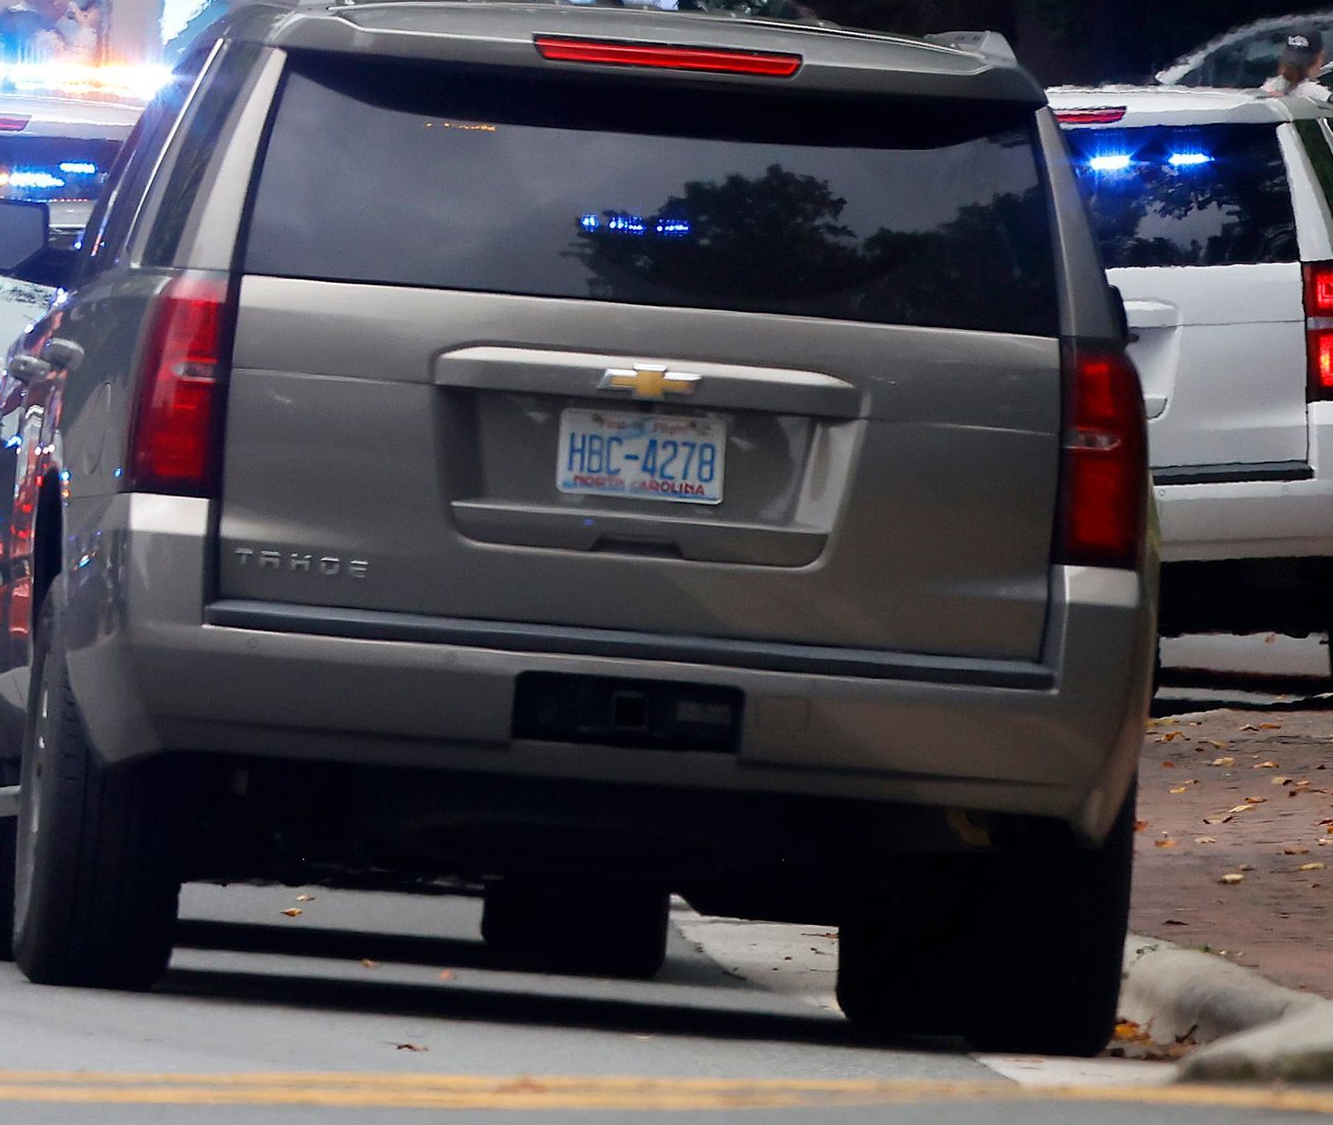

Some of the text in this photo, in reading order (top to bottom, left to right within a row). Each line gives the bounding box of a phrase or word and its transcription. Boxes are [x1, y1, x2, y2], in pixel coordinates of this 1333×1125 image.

[568, 432, 716, 483] HBC-4278
[573, 475, 706, 496] NORTH CAROLINA
[235, 547, 369, 578] TAHOE
